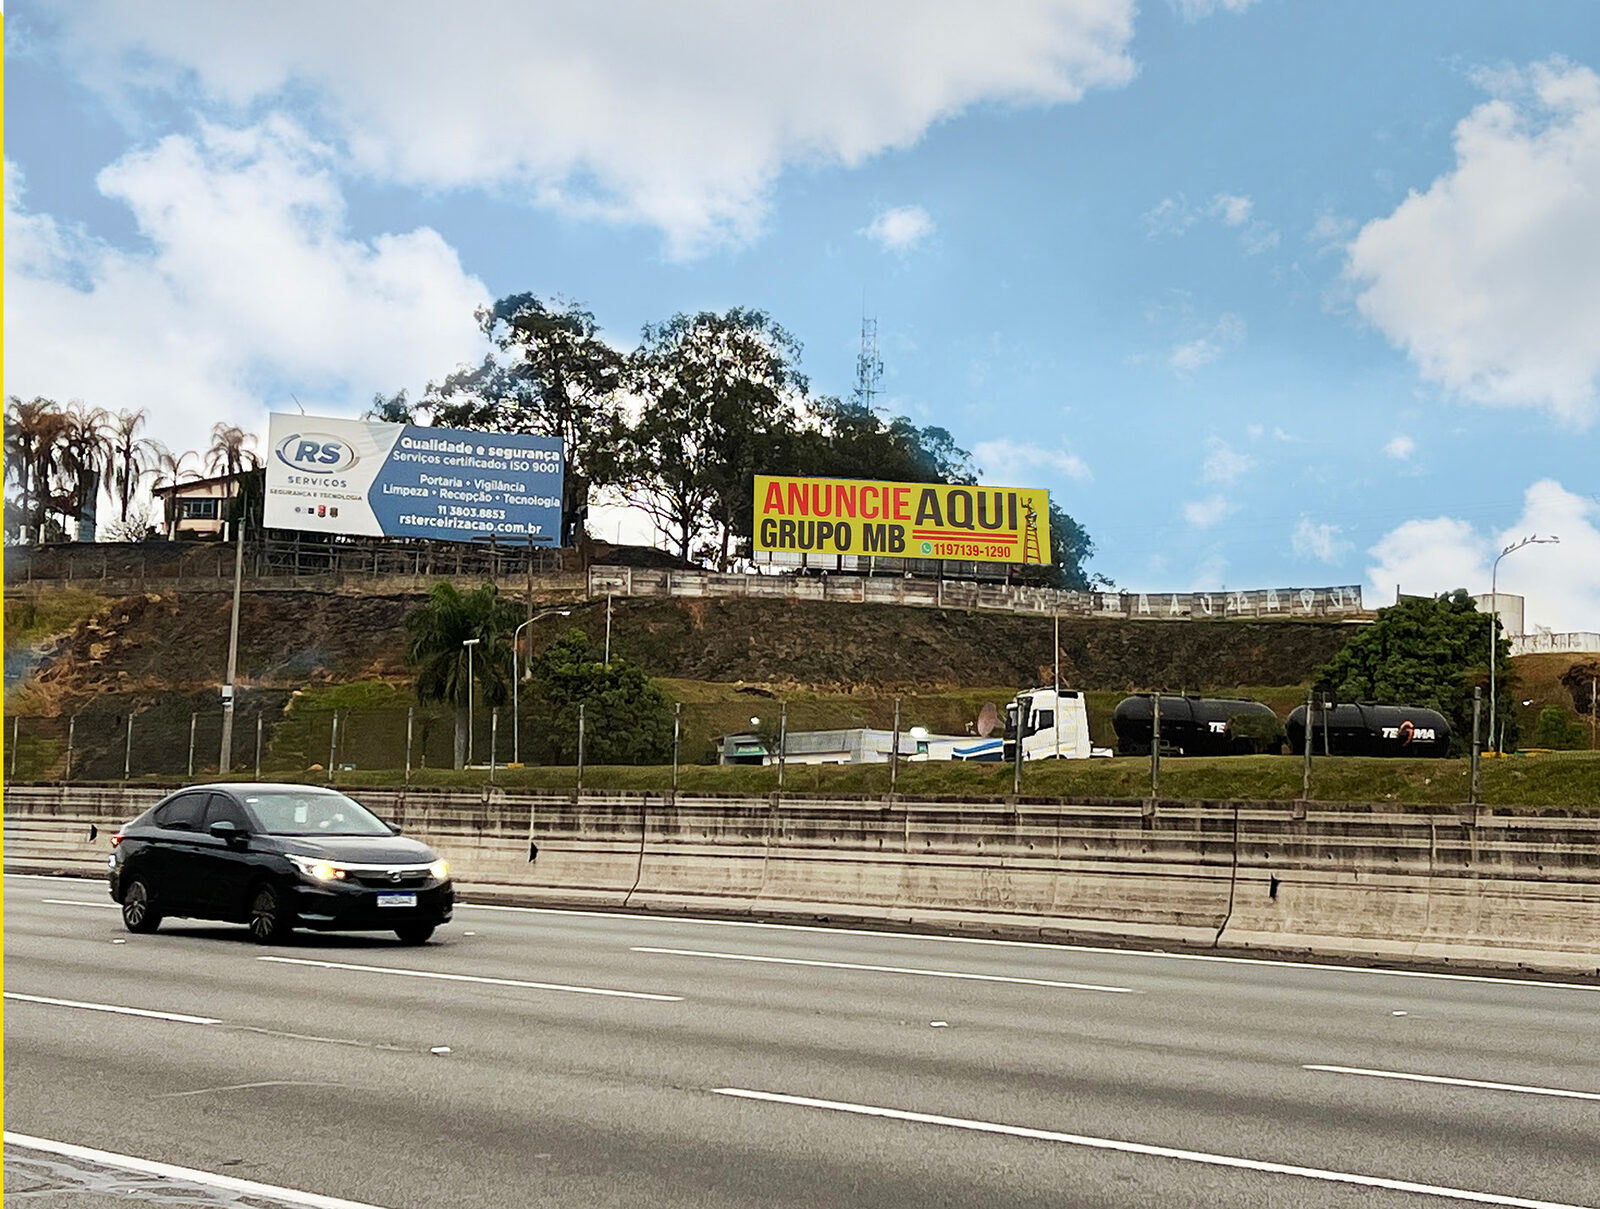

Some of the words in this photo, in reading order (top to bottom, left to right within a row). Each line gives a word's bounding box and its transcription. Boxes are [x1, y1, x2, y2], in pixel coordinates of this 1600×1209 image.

[295, 441, 342, 464] RS
[401, 437, 473, 455] Qualidade
[476, 446, 485, 456] e
[488, 447, 560, 462] segurança
[392, 451, 441, 466] Serviços
[442, 457, 508, 471] certificados
[510, 461, 529, 472] ISO
[532, 463, 560, 473] 9001
[288, 476, 347, 488] SERVIÇOS
[419, 474, 463, 488] Portaria
[474, 479, 526, 493] Vigilância
[382, 483, 429, 499] Limpeza
[439, 488, 493, 503] Recepção
[503, 493, 561, 508] Tecnologia
[763, 481, 911, 521] ANUNCIE
[914, 488, 1018, 531] AQUI
[437, 504, 447, 516] 11
[449, 505, 506, 520] 3803.8853
[399, 514, 542, 535] rsterceirizacao.com.br
[760, 517, 852, 552] GRUPO
[863, 522, 906, 554] MB
[934, 542, 1011, 559] 1197139-1290
